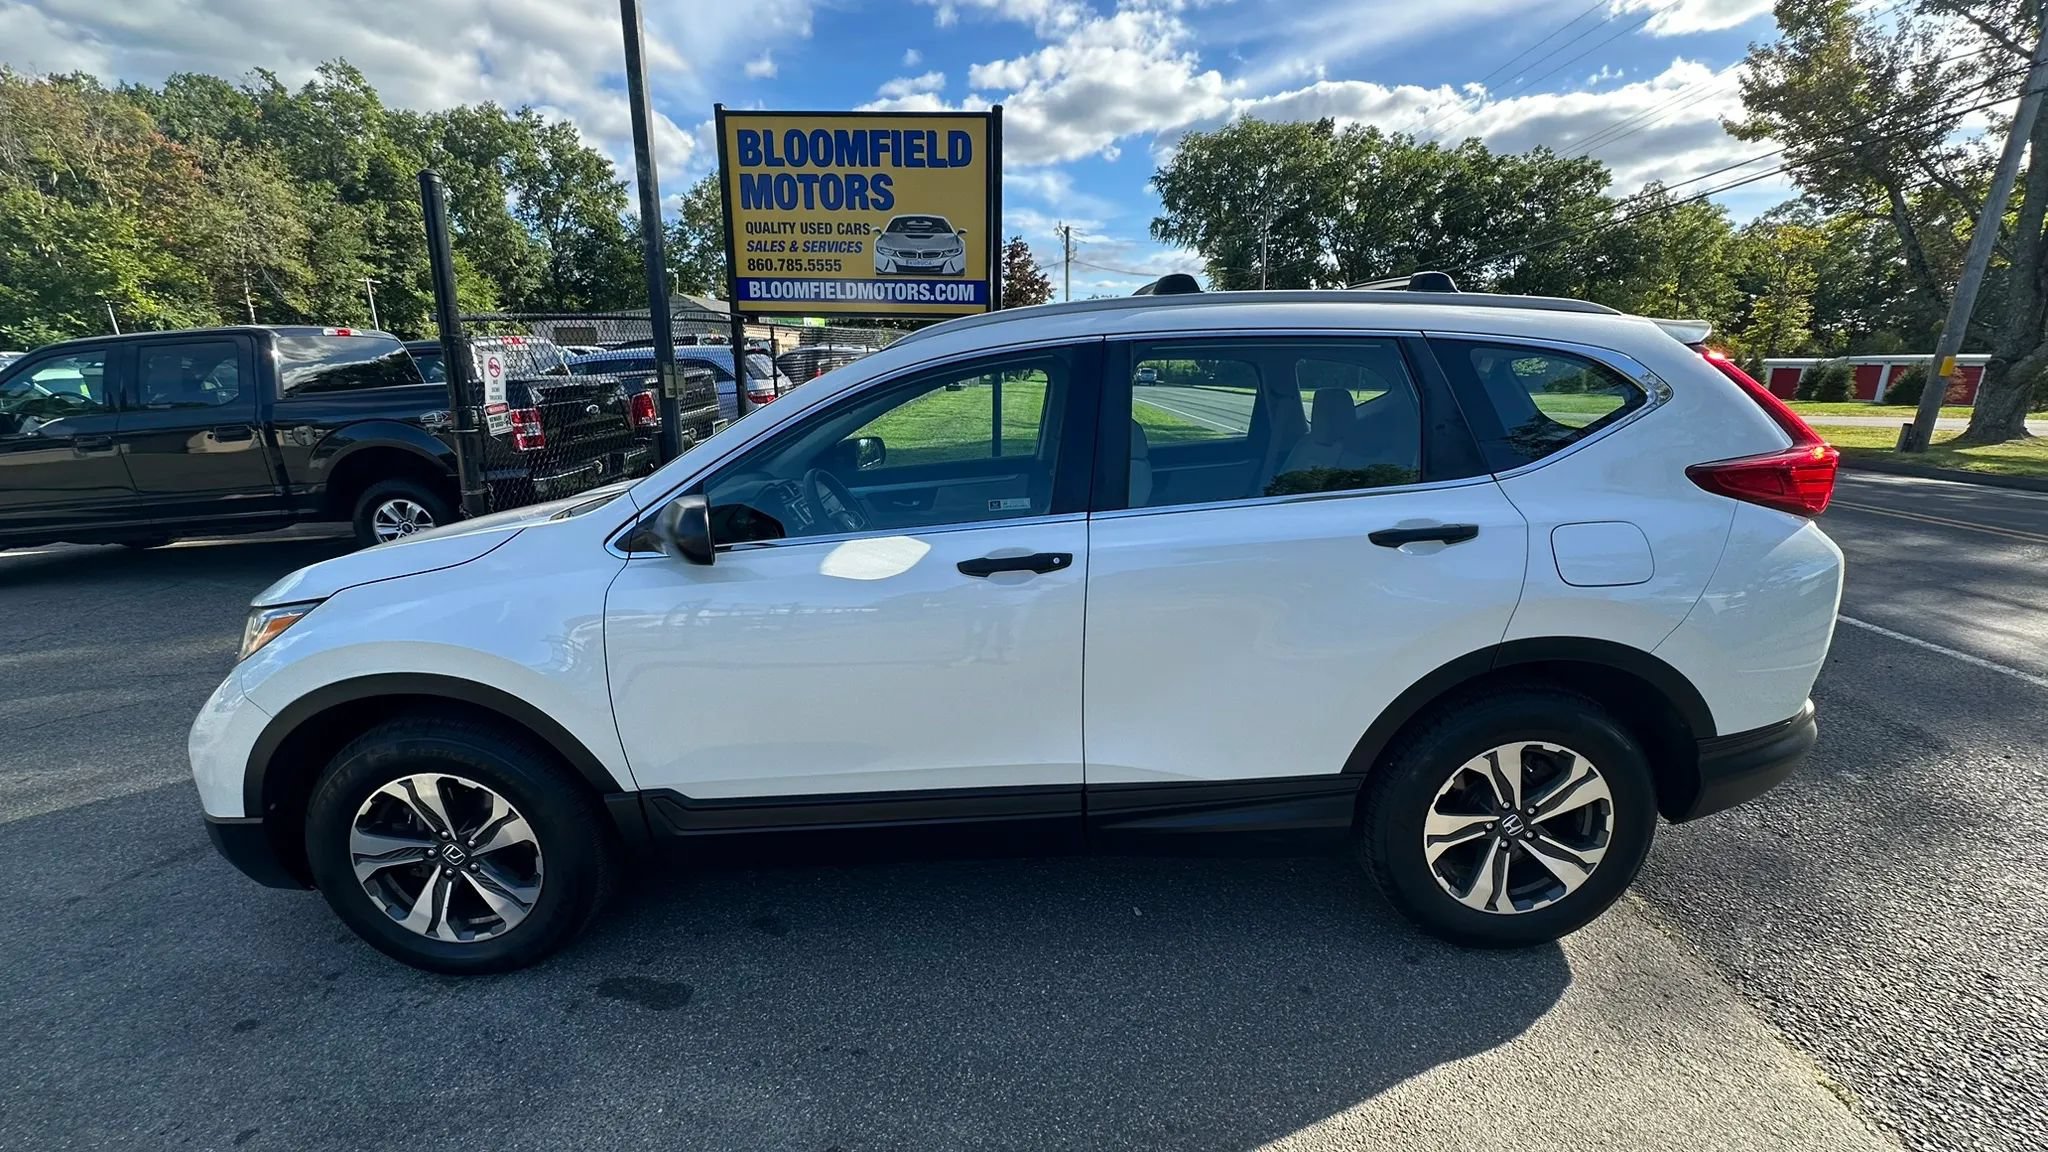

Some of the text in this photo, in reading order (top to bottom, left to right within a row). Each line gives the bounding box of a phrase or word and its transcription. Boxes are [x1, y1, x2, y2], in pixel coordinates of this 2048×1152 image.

[737, 129, 972, 168] BLOOMFIELD
[739, 173, 895, 211] MOTORS
[745, 221, 870, 235] QUALITY USED CARS
[746, 240, 862, 253] SALES & SERVICES
[747, 258, 842, 272] 860.785.5555
[749, 281, 975, 301] BLOOMFIELDMOTORS.COM
